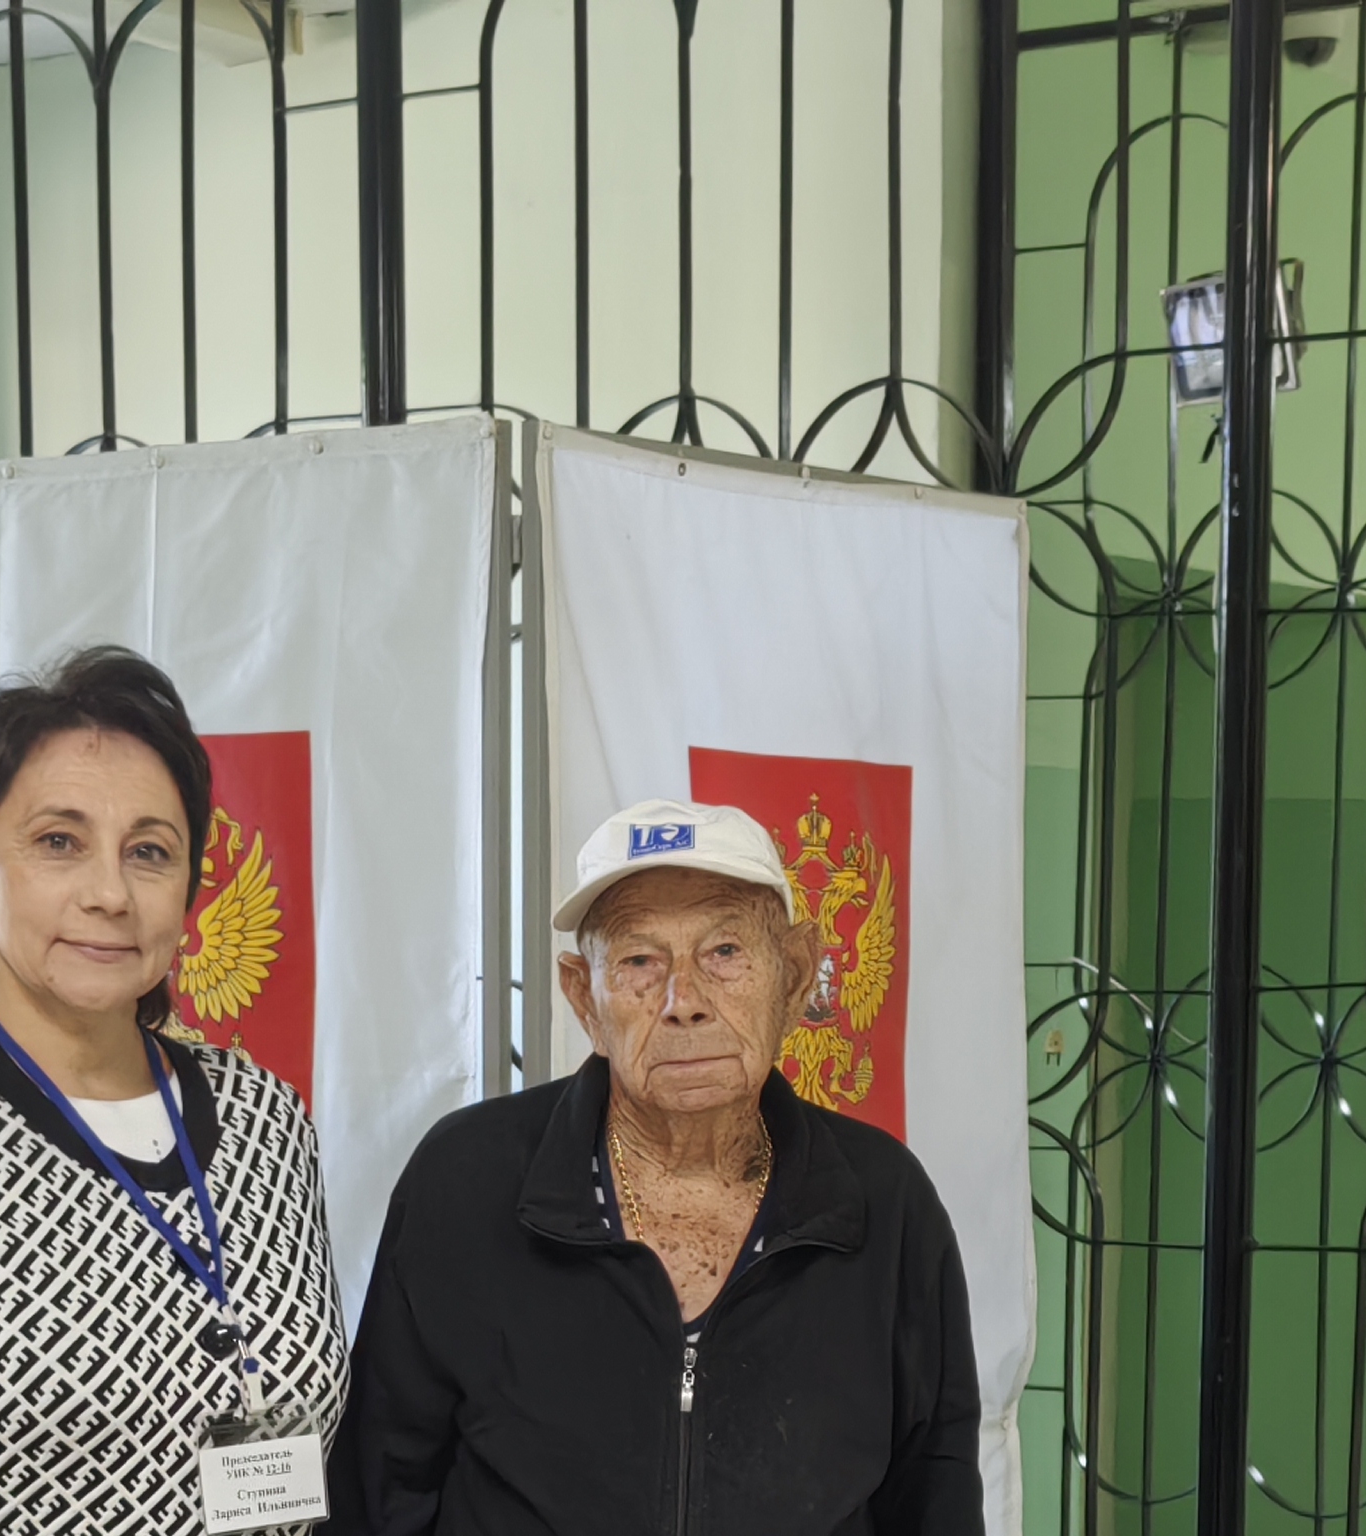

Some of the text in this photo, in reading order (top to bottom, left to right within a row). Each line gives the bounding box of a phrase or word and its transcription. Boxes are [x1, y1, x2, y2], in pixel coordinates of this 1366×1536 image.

[222, 1450, 292, 1468] Председатель
[227, 1468, 249, 1479] УИК
[212, 1507, 251, 1521] Лариса
